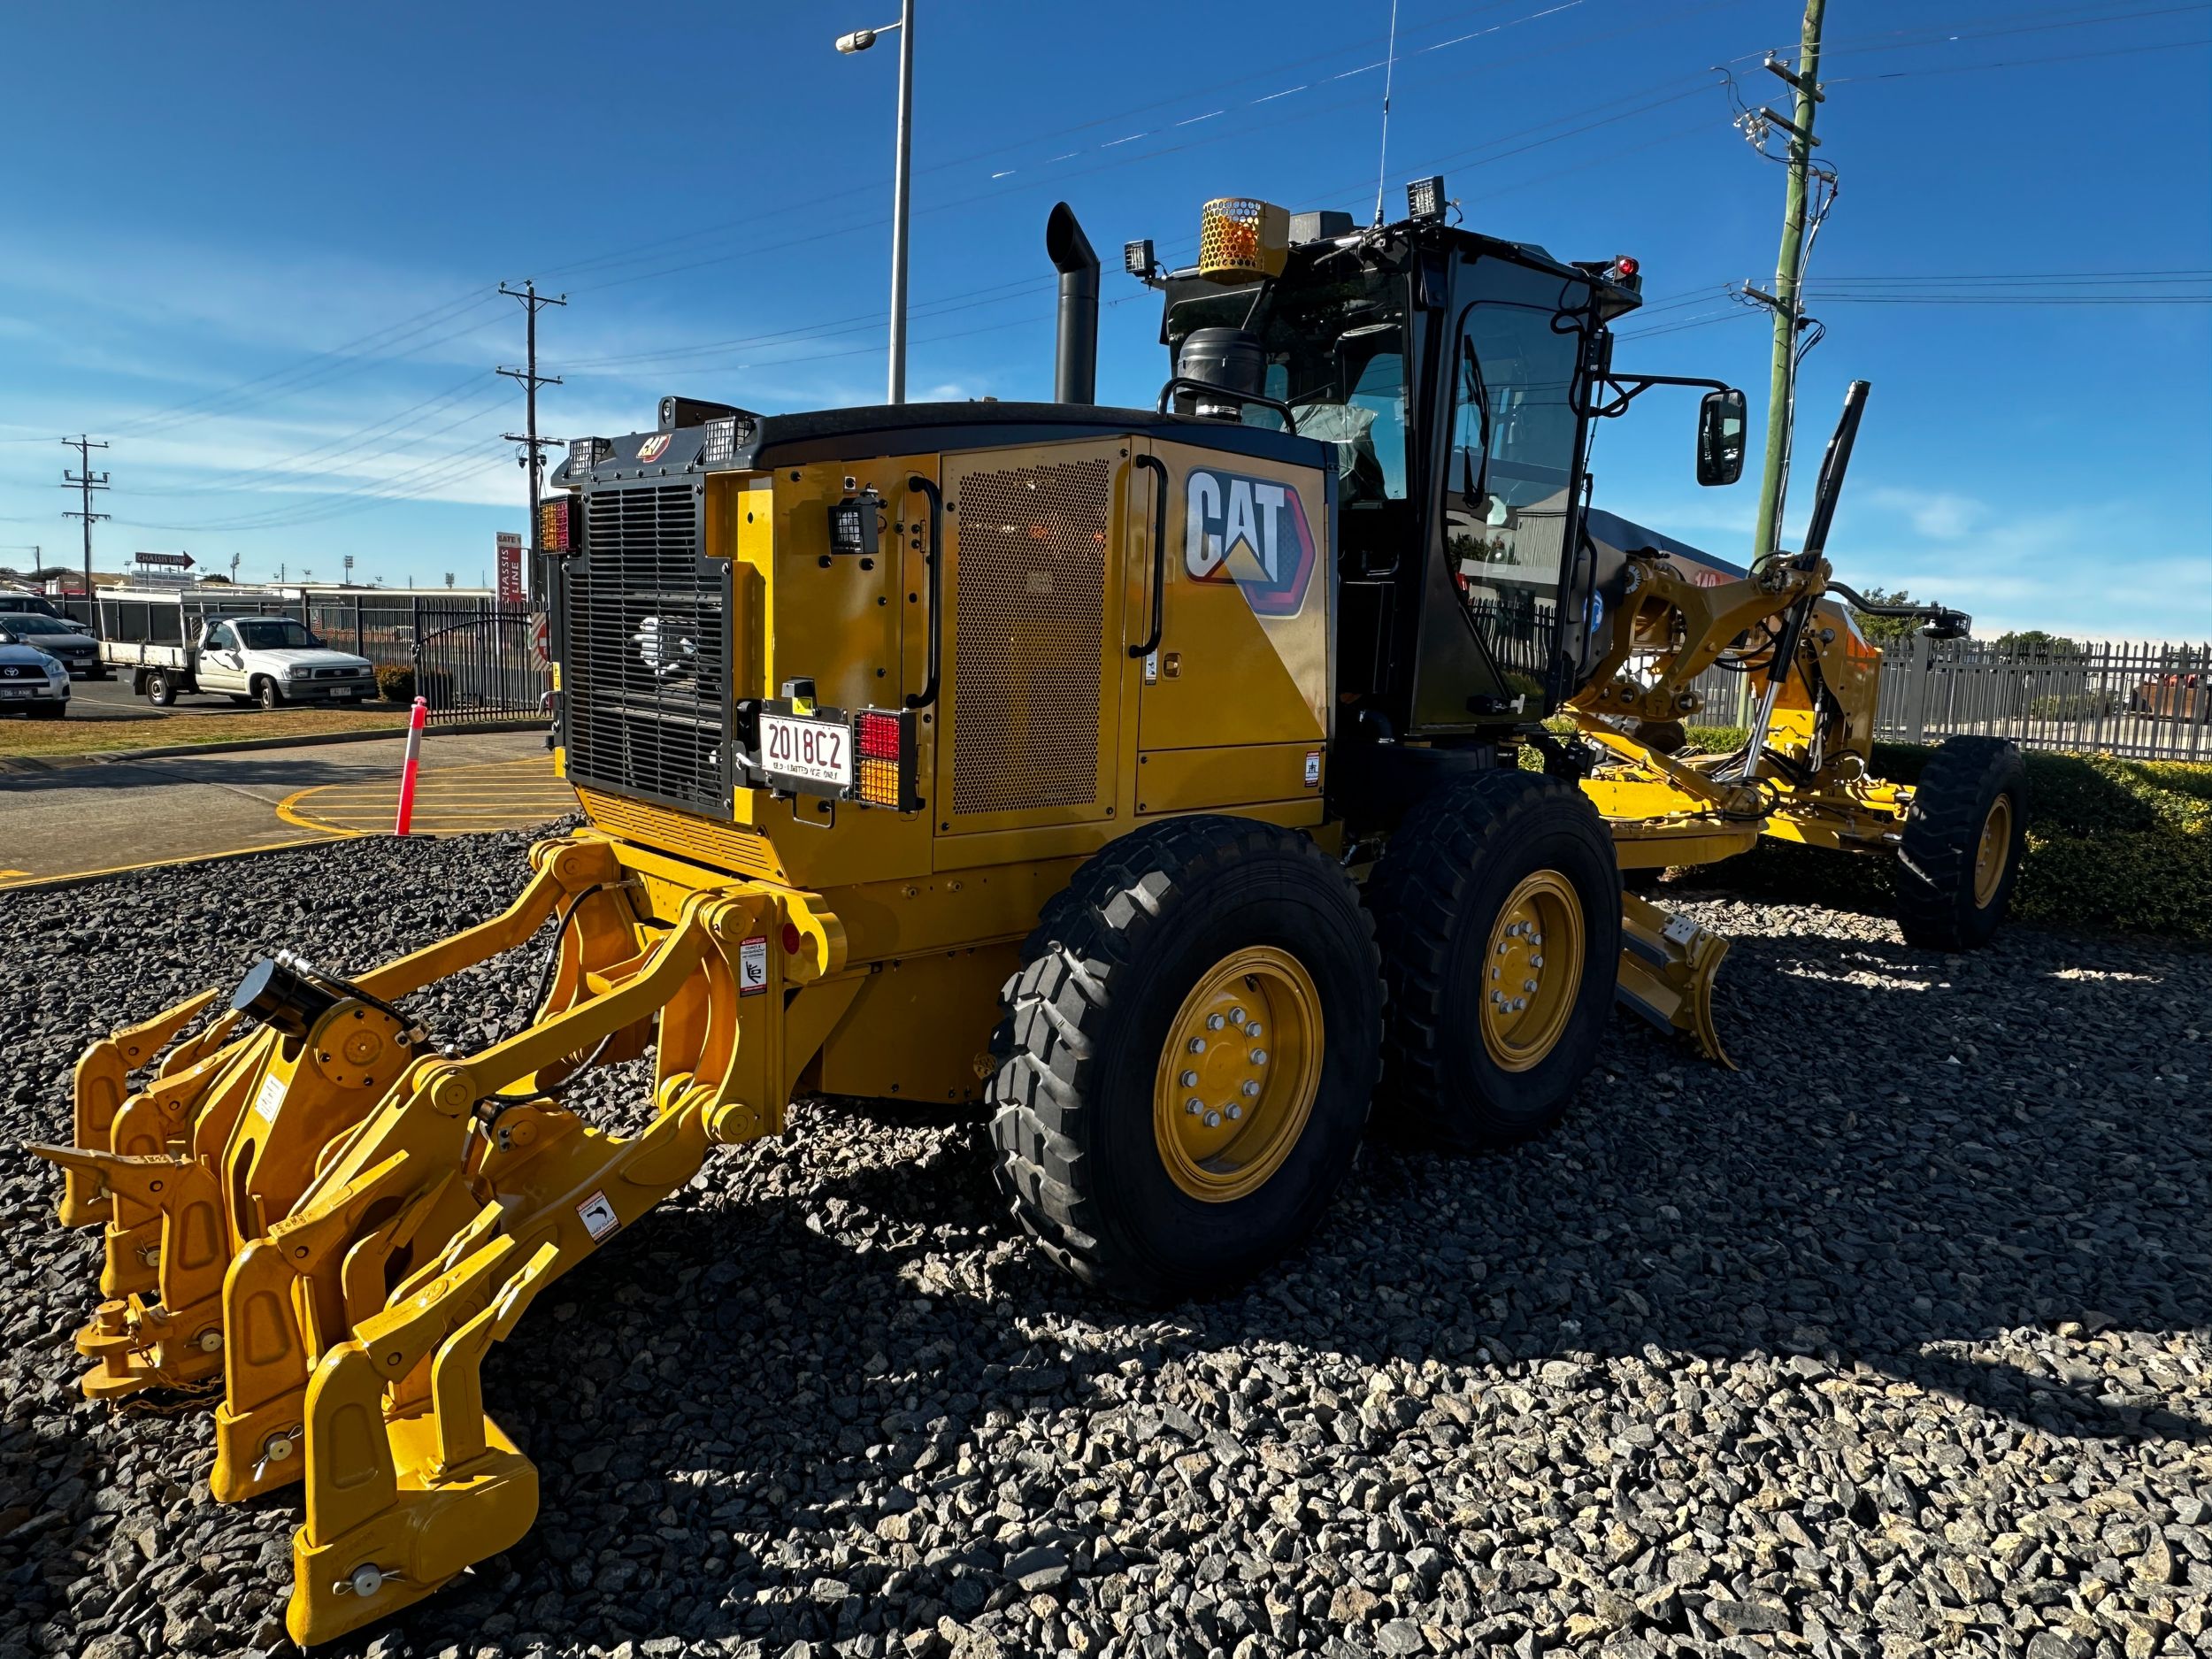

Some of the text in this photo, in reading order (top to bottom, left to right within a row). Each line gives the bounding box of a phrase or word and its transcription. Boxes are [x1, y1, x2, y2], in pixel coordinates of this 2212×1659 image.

[636, 434, 668, 457] CAT
[1186, 472, 1285, 583] CAT
[138, 554, 185, 565] CHASSIS LINE
[769, 723, 841, 770] 2018C2
